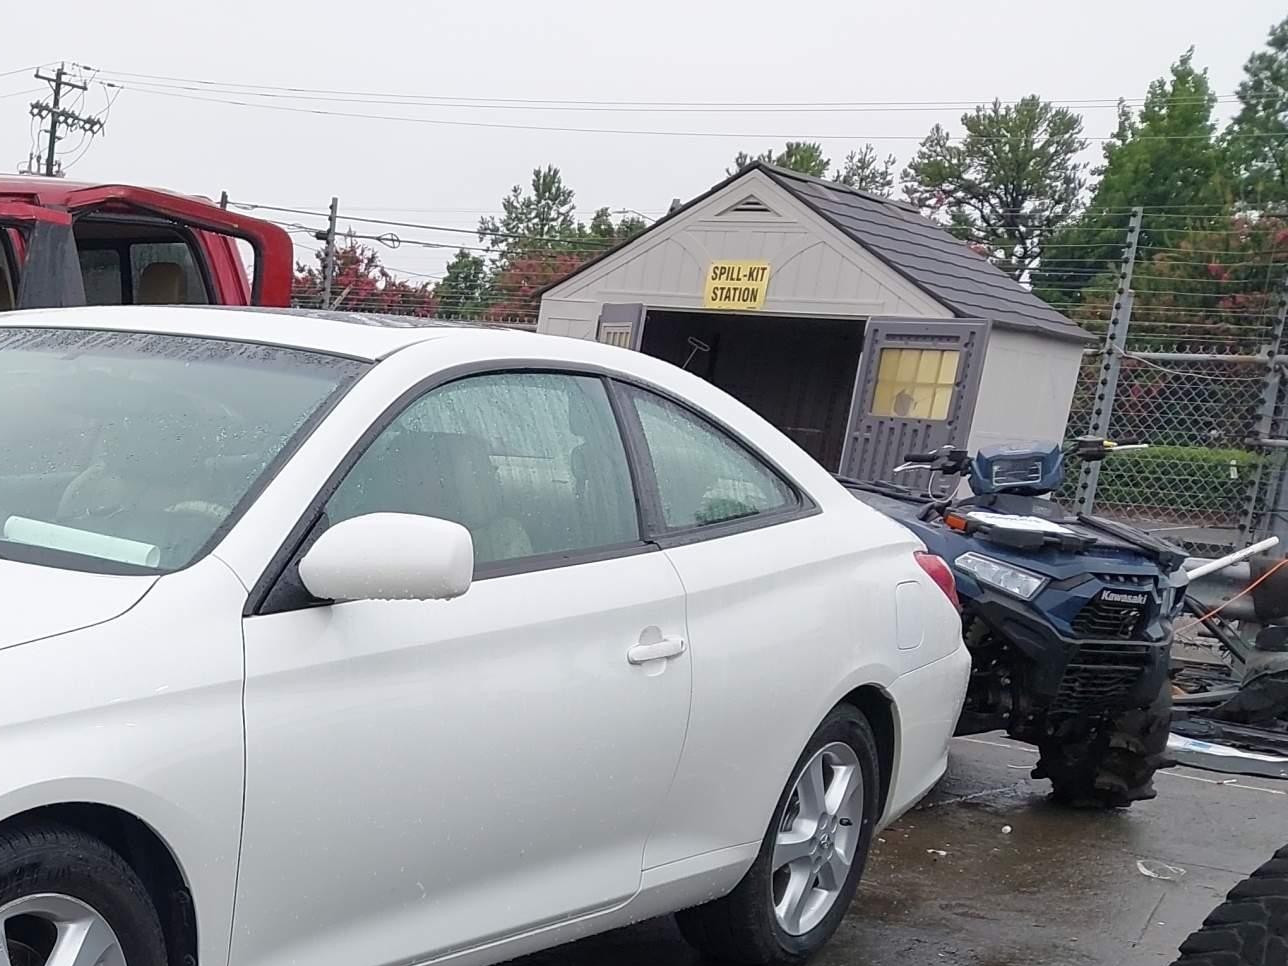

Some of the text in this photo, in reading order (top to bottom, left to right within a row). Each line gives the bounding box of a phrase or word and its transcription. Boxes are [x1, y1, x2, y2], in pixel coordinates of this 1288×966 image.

[711, 266, 767, 281] SPILL-KIT
[711, 286, 759, 302] STATION
[1101, 590, 1147, 604] Kawasaki
